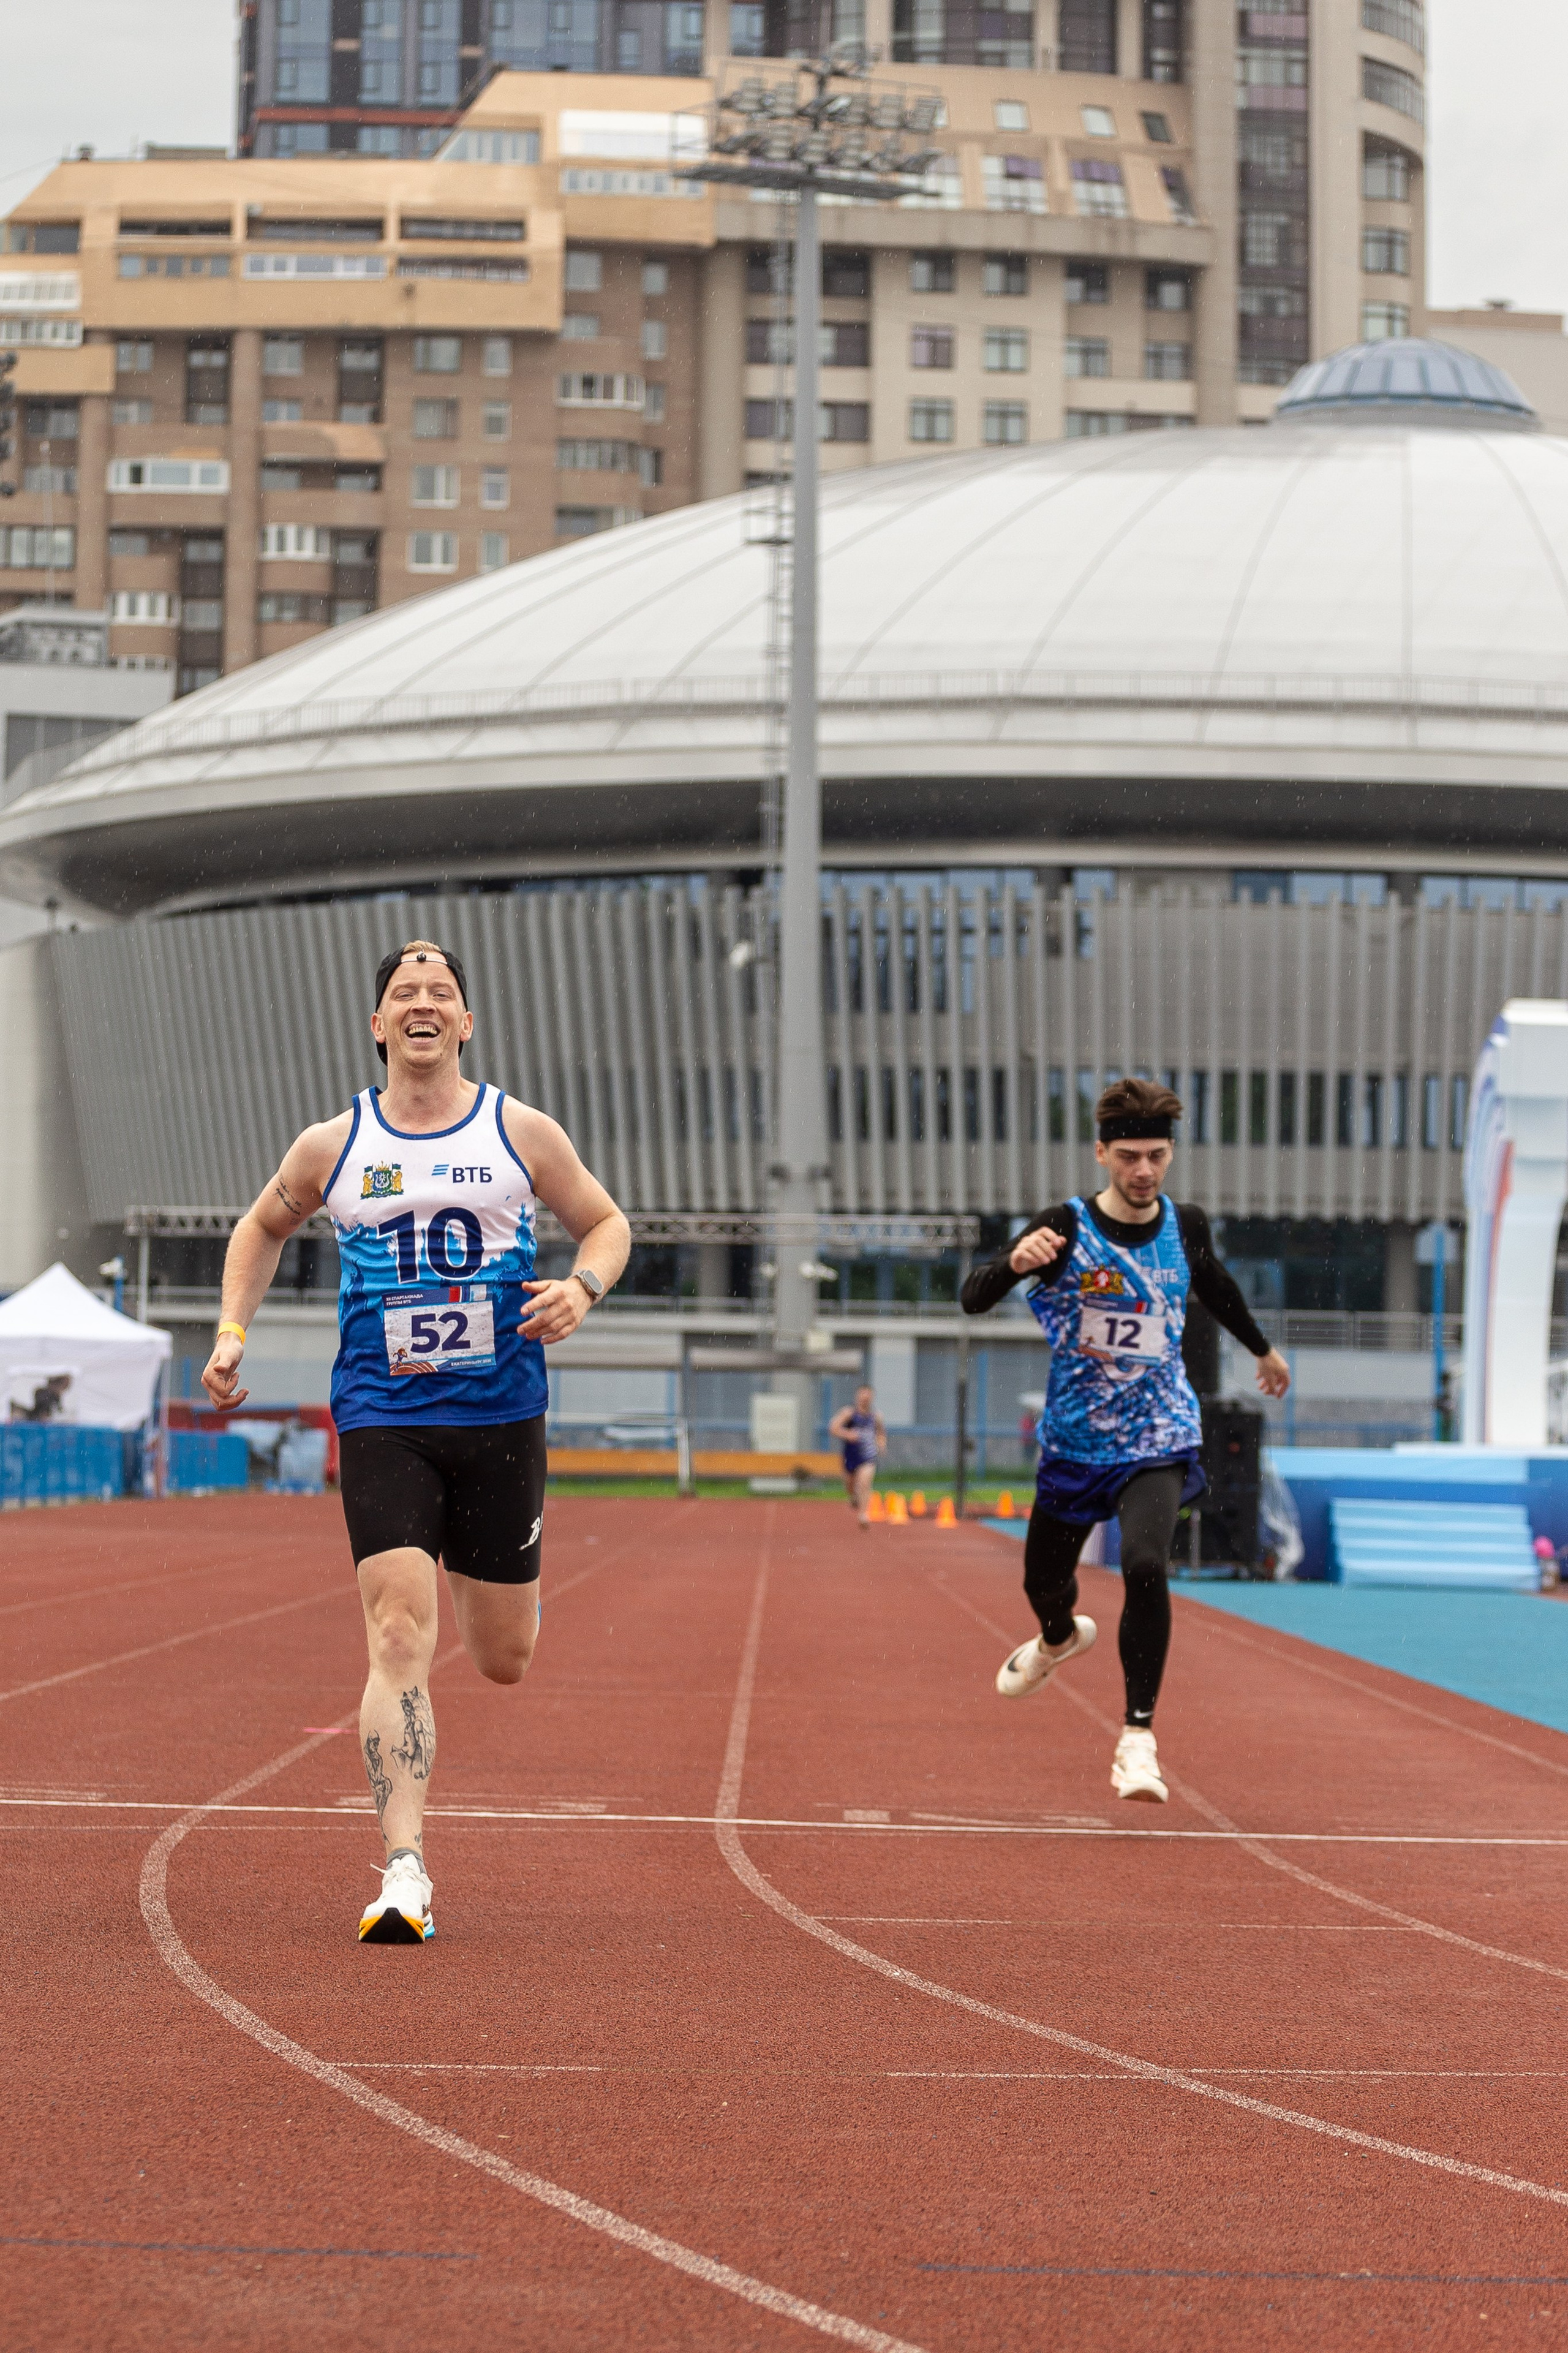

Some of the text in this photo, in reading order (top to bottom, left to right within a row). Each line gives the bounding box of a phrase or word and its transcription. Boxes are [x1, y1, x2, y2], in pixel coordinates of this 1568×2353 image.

[452, 1167, 492, 1183] ВТБ
[377, 1207, 484, 1284] 10
[410, 1311, 471, 1353] 52
[1105, 1318, 1141, 1348] 12
